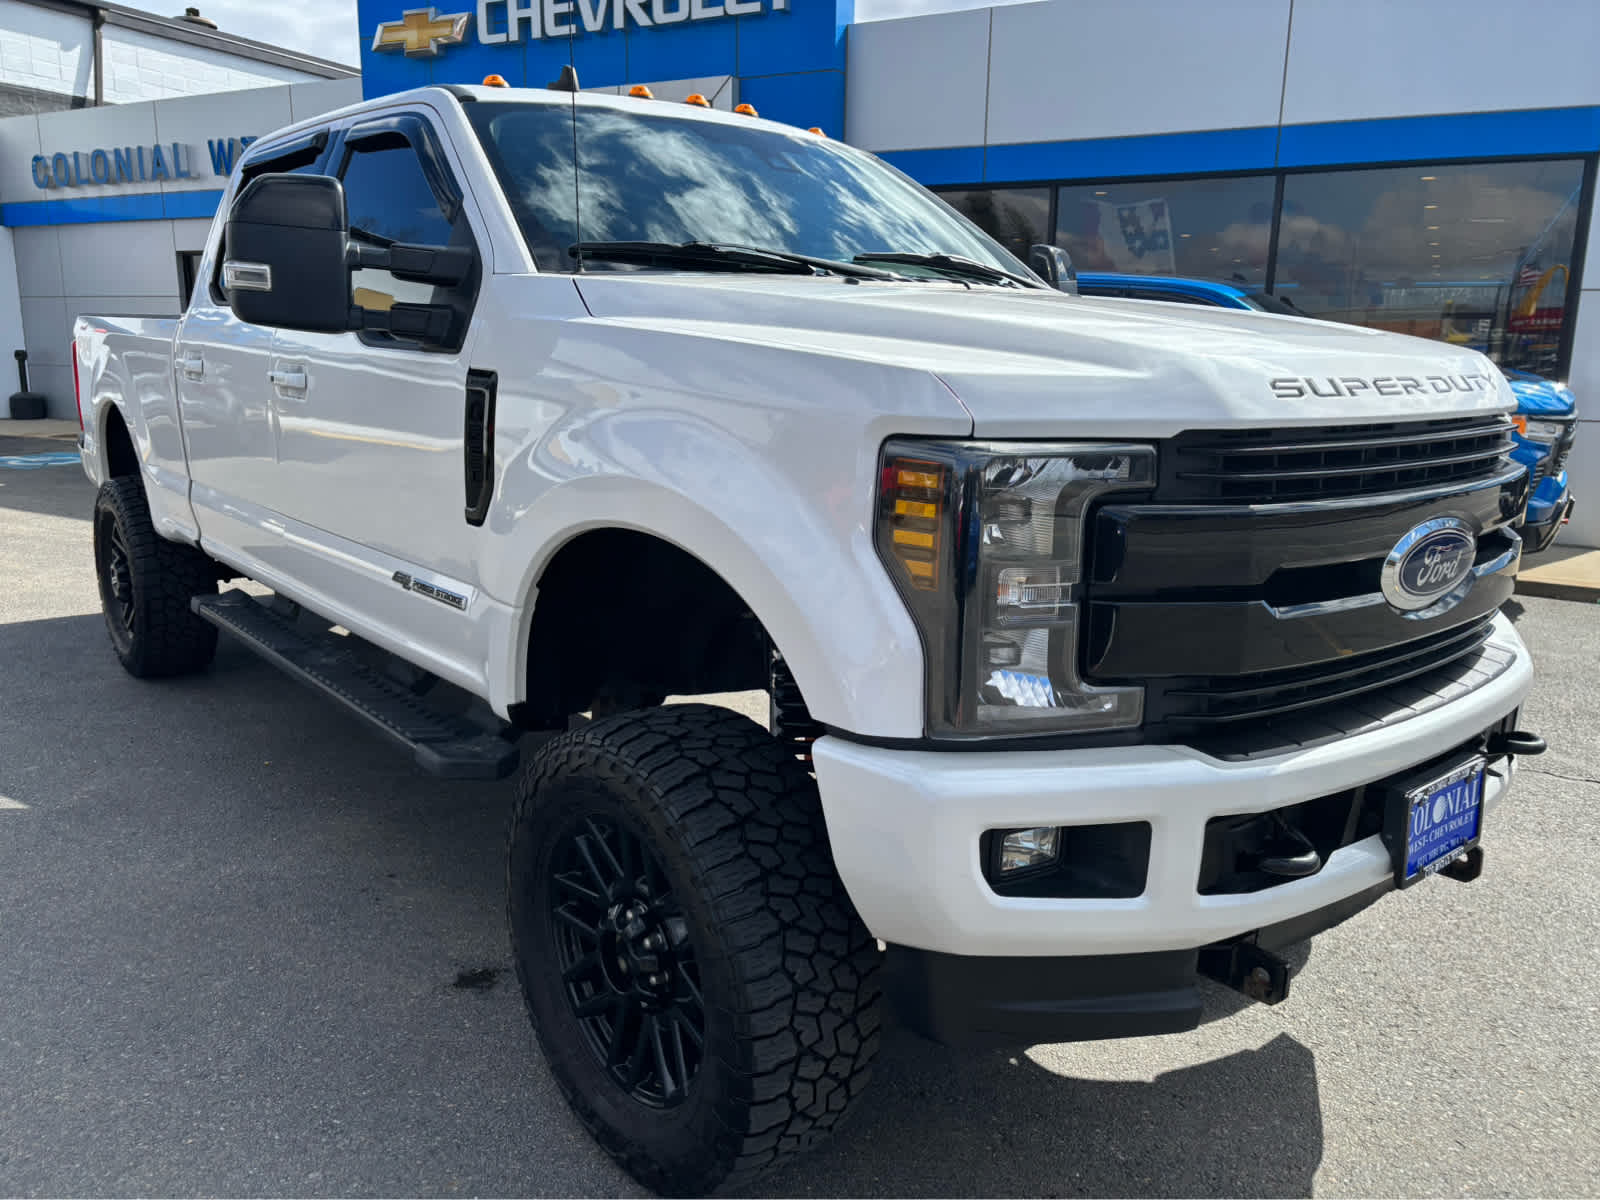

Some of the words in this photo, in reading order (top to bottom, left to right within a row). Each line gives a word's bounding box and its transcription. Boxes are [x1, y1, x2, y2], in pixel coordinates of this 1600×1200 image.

[476, 0, 785, 44] CHEVRO
[32, 143, 191, 189] COLONIAL
[1269, 376, 1427, 398] SUPER
[1427, 373, 1498, 393] DUTY
[1417, 543, 1465, 586] Ford
[1409, 780, 1480, 838] OLONIAL
